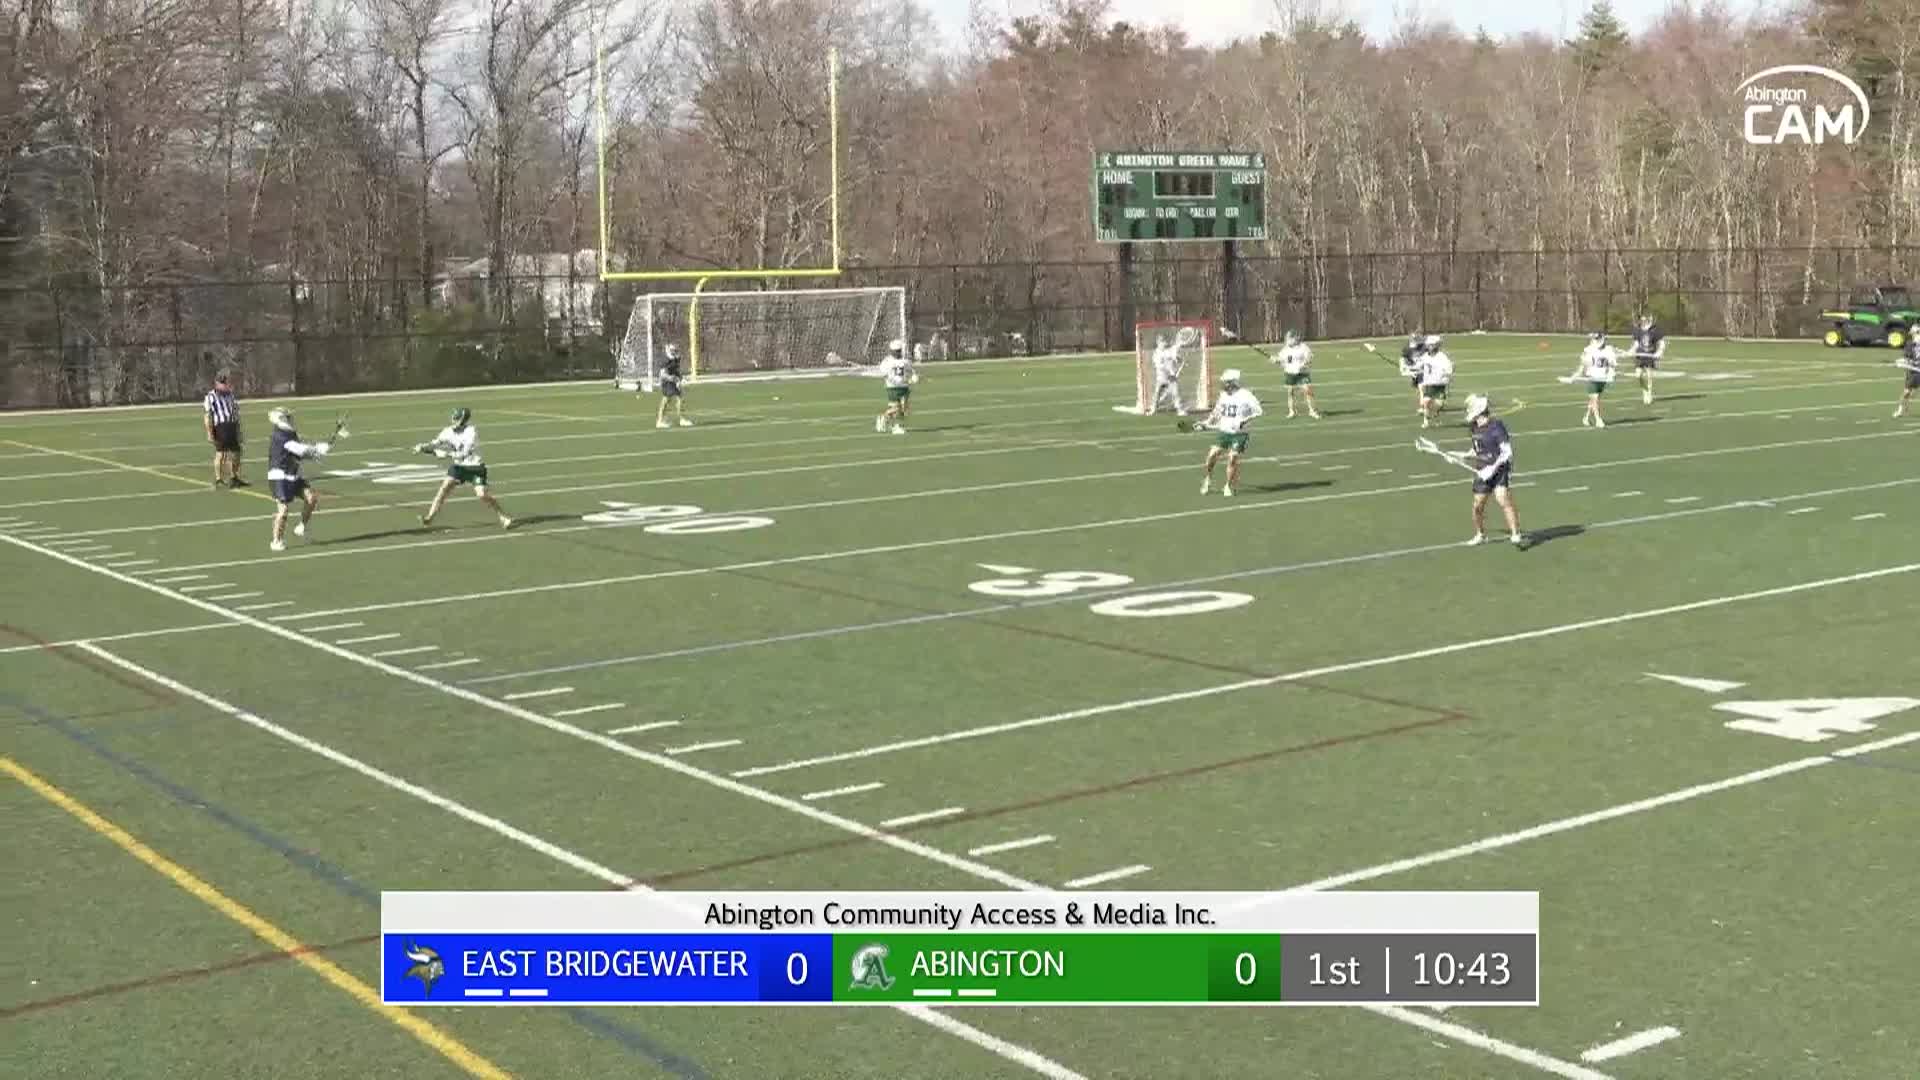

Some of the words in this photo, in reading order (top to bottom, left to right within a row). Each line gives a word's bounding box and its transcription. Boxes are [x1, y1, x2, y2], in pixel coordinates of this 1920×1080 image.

[1116, 154, 1174, 166] ABINGTON
[1179, 154, 1214, 166] GREEN
[1218, 154, 1250, 166] WAVE
[1103, 171, 1133, 184] HOME
[1231, 171, 1261, 184] GUEST
[968, 571, 1254, 617] 30
